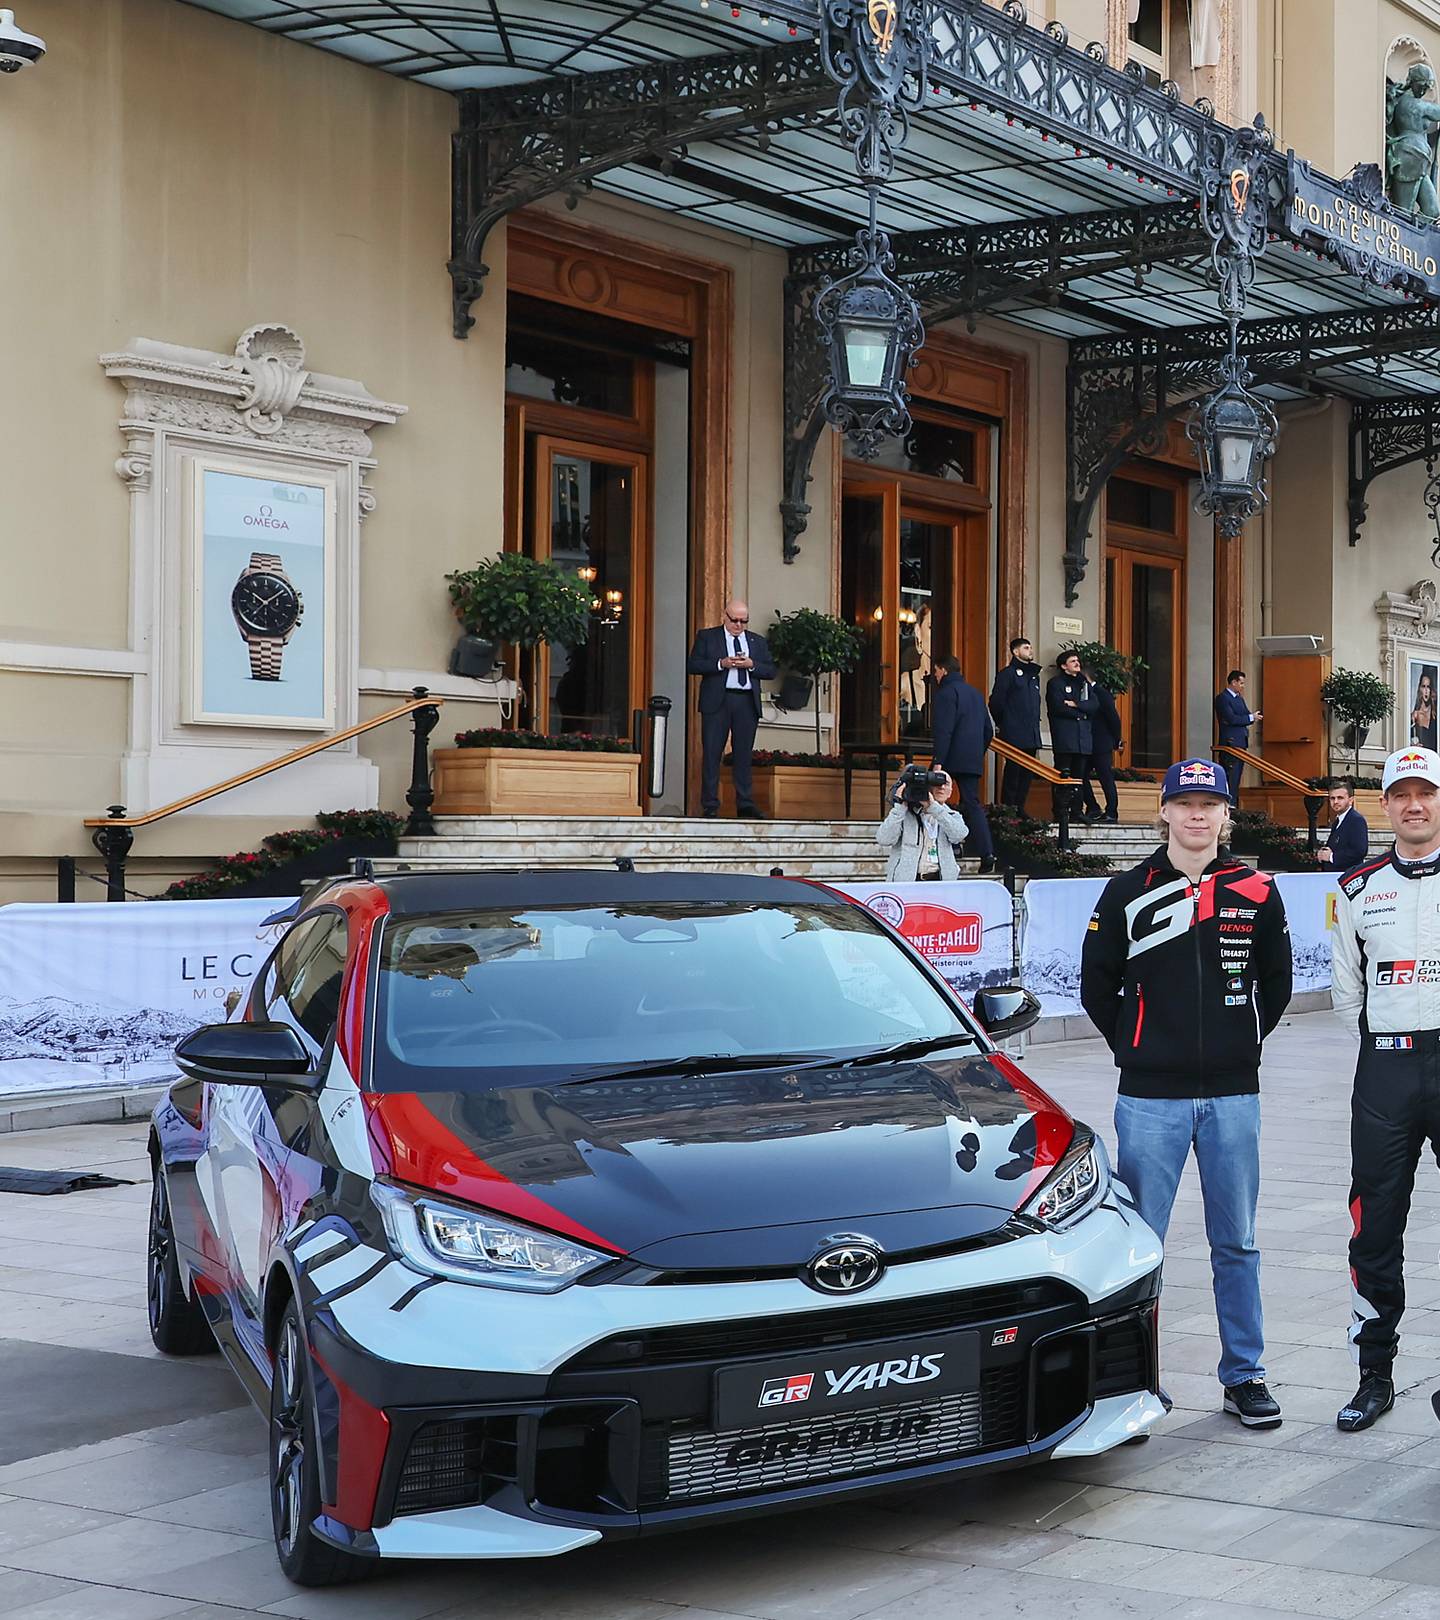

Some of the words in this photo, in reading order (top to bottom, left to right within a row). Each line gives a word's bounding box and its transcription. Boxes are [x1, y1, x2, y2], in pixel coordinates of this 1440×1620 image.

[1334, 197, 1401, 242] CASINO
[243, 515, 289, 530] OMEGA
[1396, 763, 1412, 773] Red
[1412, 762, 1429, 771] Bull
[1180, 774, 1198, 786] Red
[1199, 775, 1216, 786] Bull
[1364, 891, 1398, 904] DENSO
[1363, 906, 1397, 917] Panasonic
[1219, 924, 1253, 933] DENSO
[182, 955, 218, 981] LE
[1377, 970, 1412, 984] GR
[1375, 1039, 1394, 1048] OMP
[993, 1332, 1014, 1345] GR
[761, 1384, 810, 1405] GR
